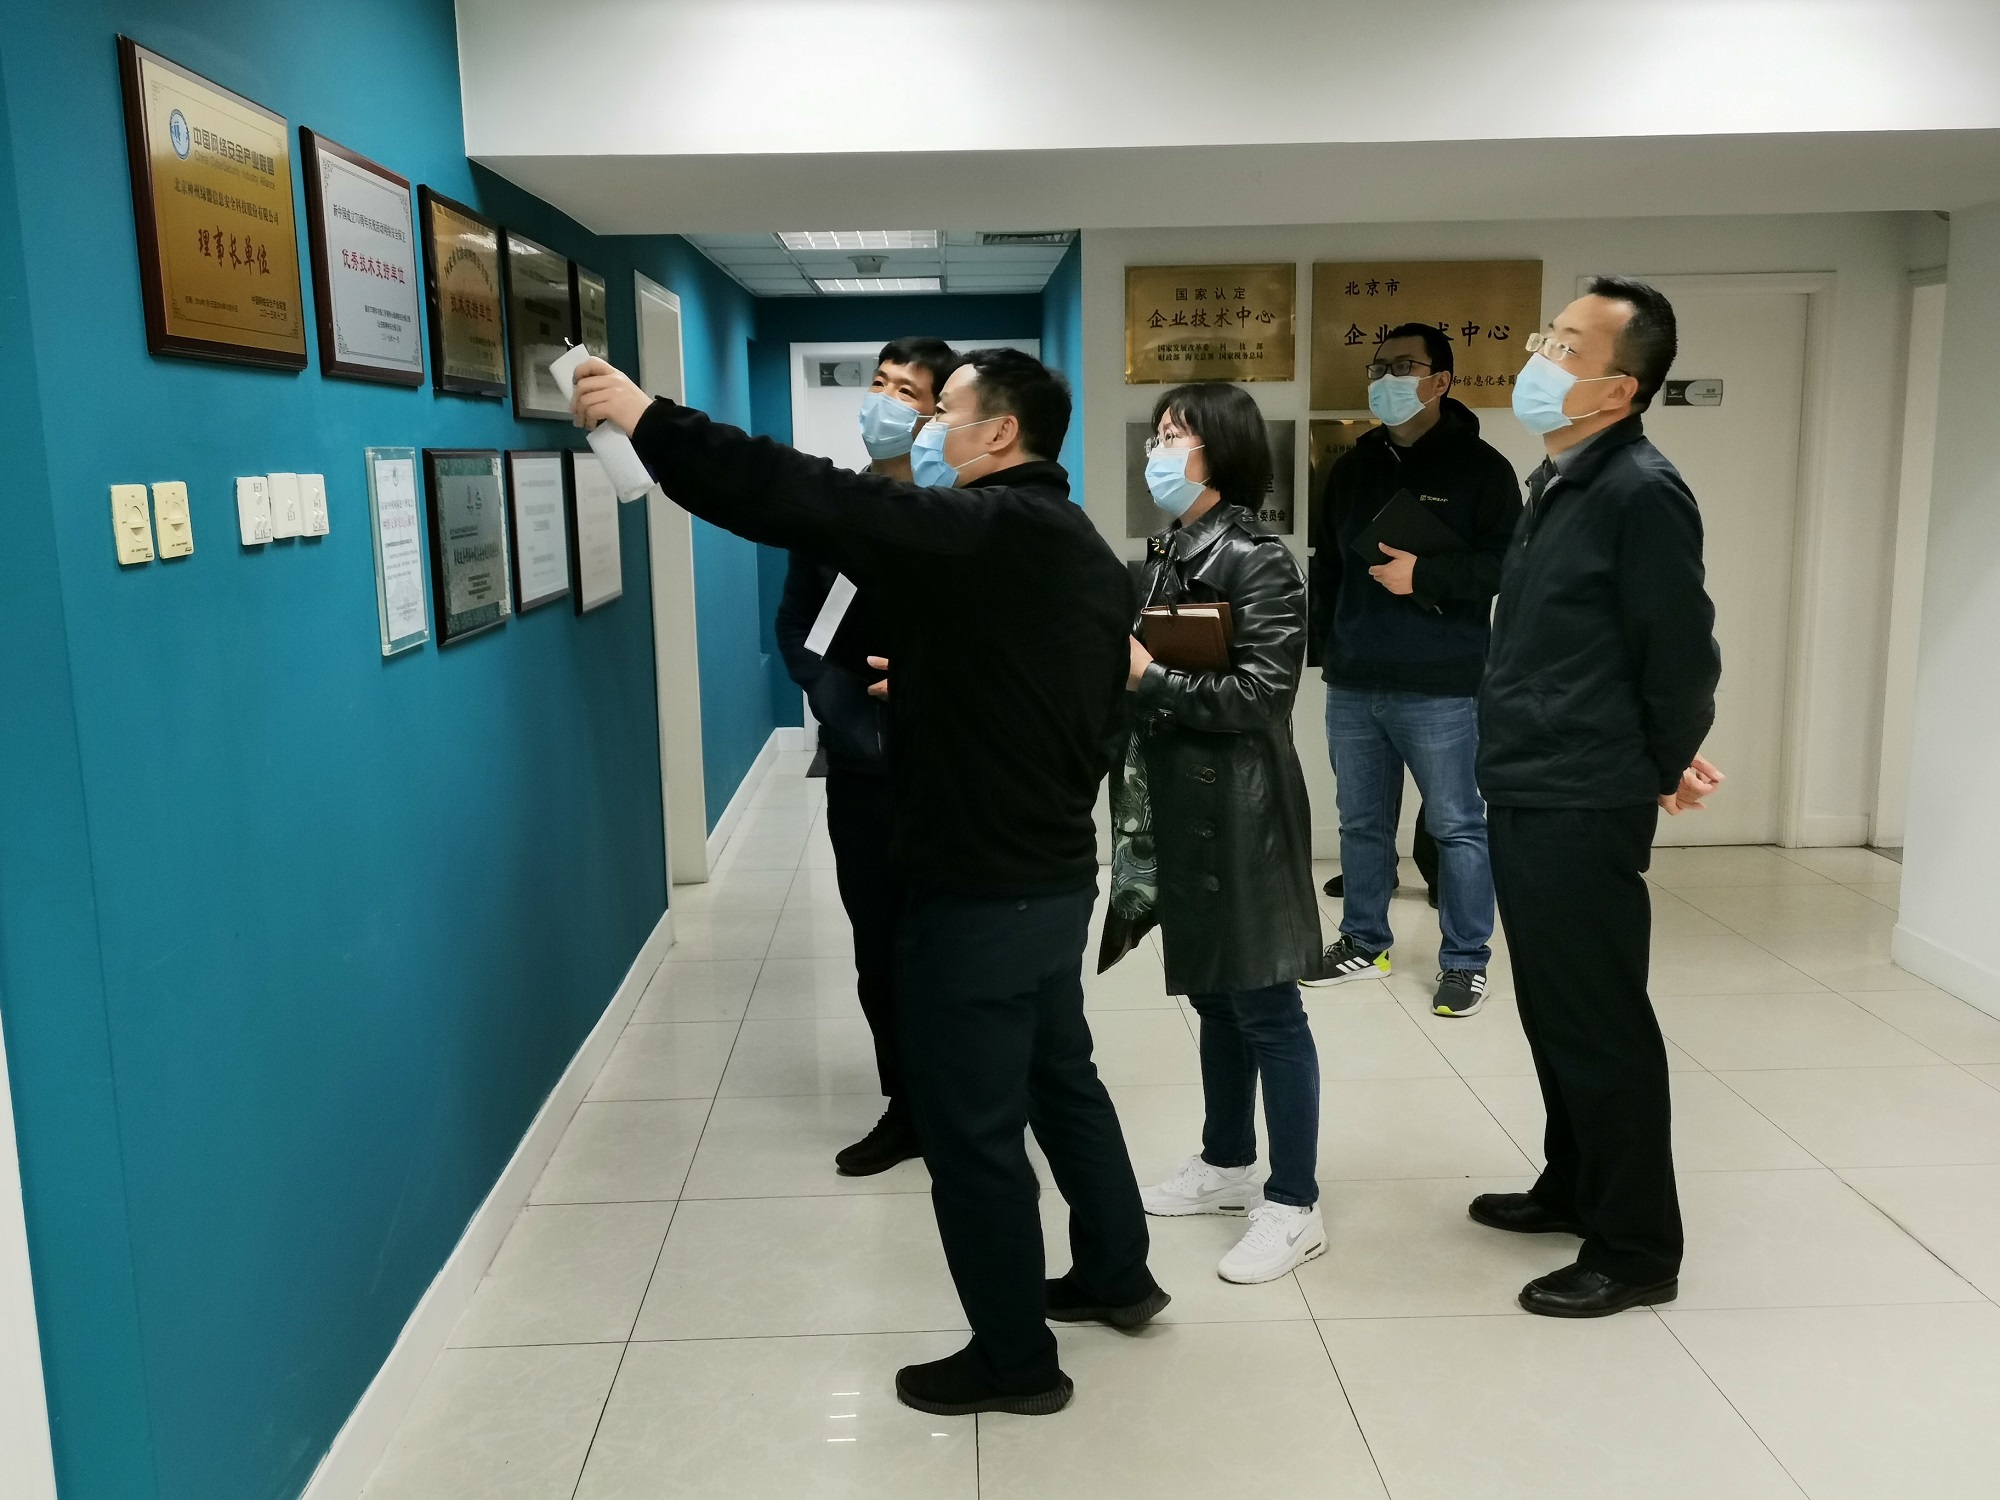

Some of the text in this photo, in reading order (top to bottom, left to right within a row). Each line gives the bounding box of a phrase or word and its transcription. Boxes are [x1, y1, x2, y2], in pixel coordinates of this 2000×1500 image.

[193, 126, 275, 176] 中国网络安全产业联盟
[198, 225, 271, 276] 理事长单位
[341, 248, 406, 285] 优秀技术支持单位
[1175, 287, 1246, 301] 国家认定
[1344, 278, 1400, 297] 北京市
[1146, 305, 1276, 329] 企业技术中心
[1344, 320, 1510, 347] 企业术中心
[1157, 342, 1210, 353] 国家发展改革委
[1157, 351, 1264, 362] 财政部 海关总署 国家税务总局
[1259, 509, 1286, 522] 委员会
